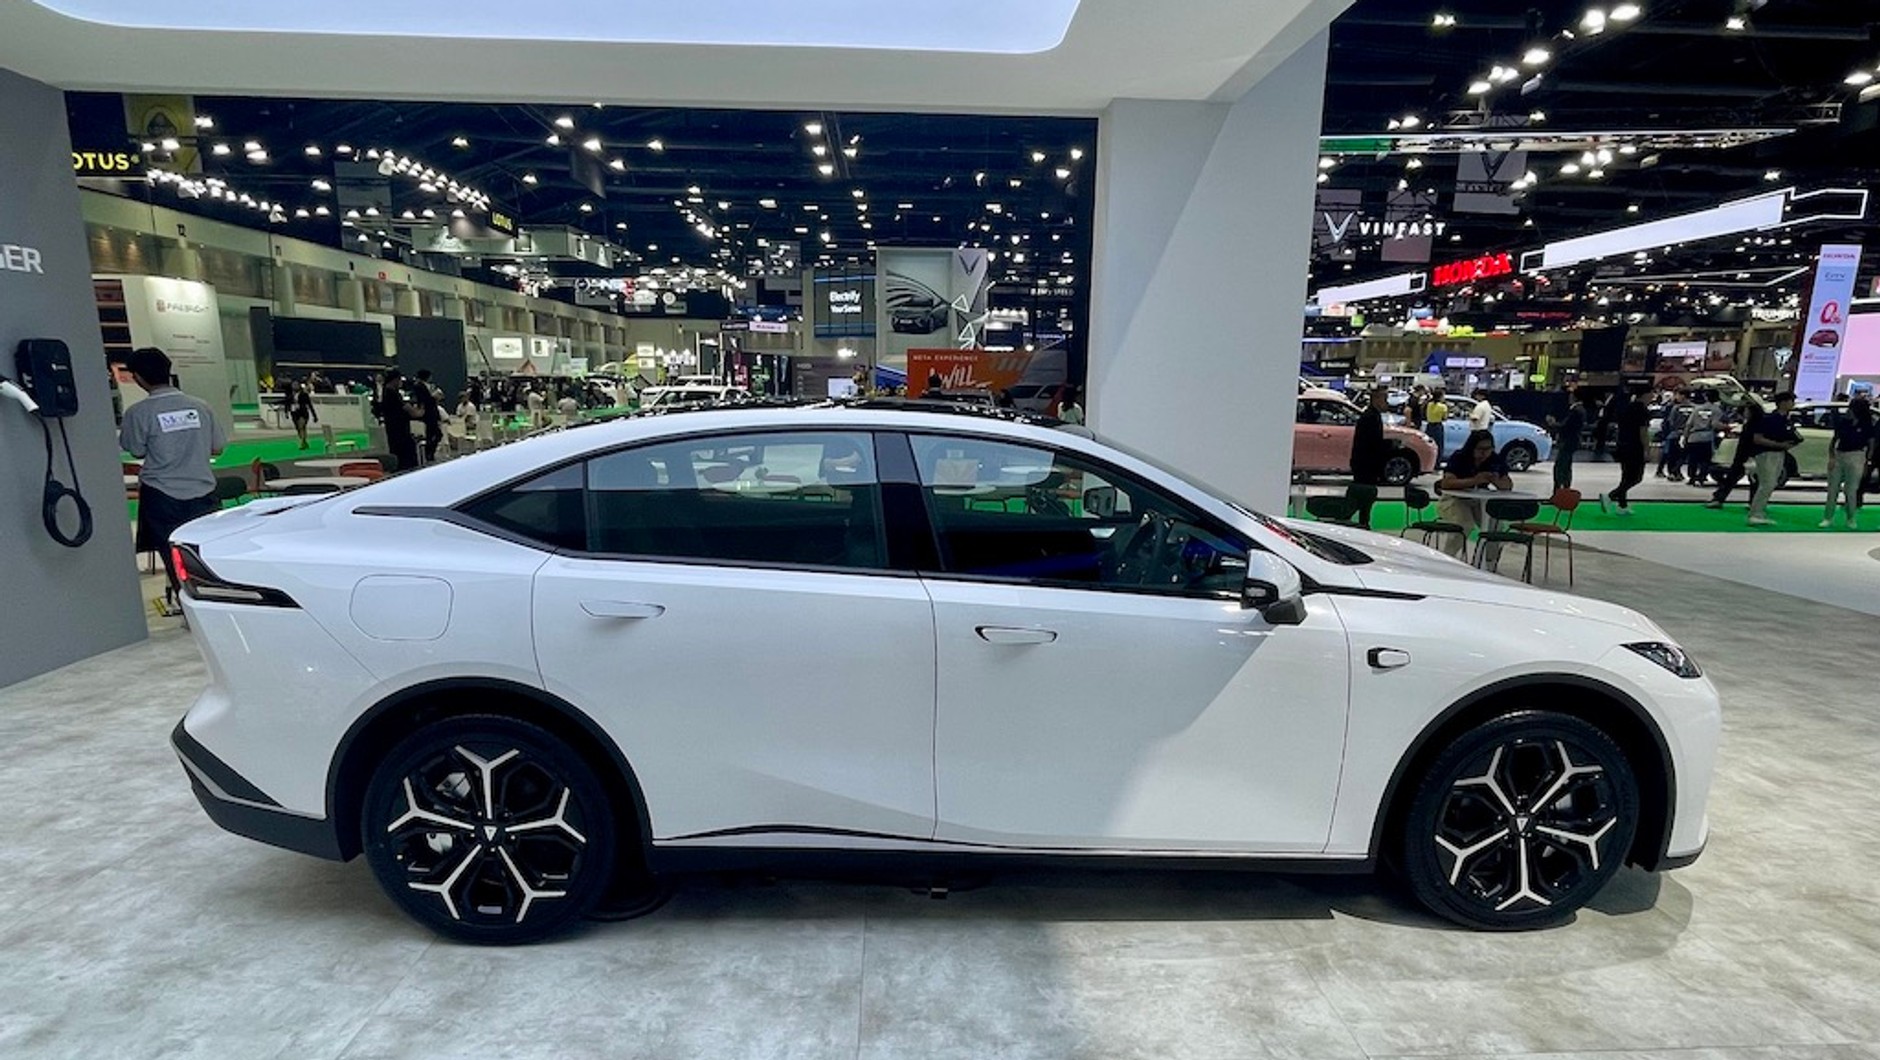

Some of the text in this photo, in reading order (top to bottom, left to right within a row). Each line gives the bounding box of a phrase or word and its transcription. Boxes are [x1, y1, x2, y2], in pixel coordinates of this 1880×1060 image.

[1359, 222, 1447, 236] VINFAST
[0, 245, 44, 274] ER
[1433, 253, 1512, 287] HONDA
